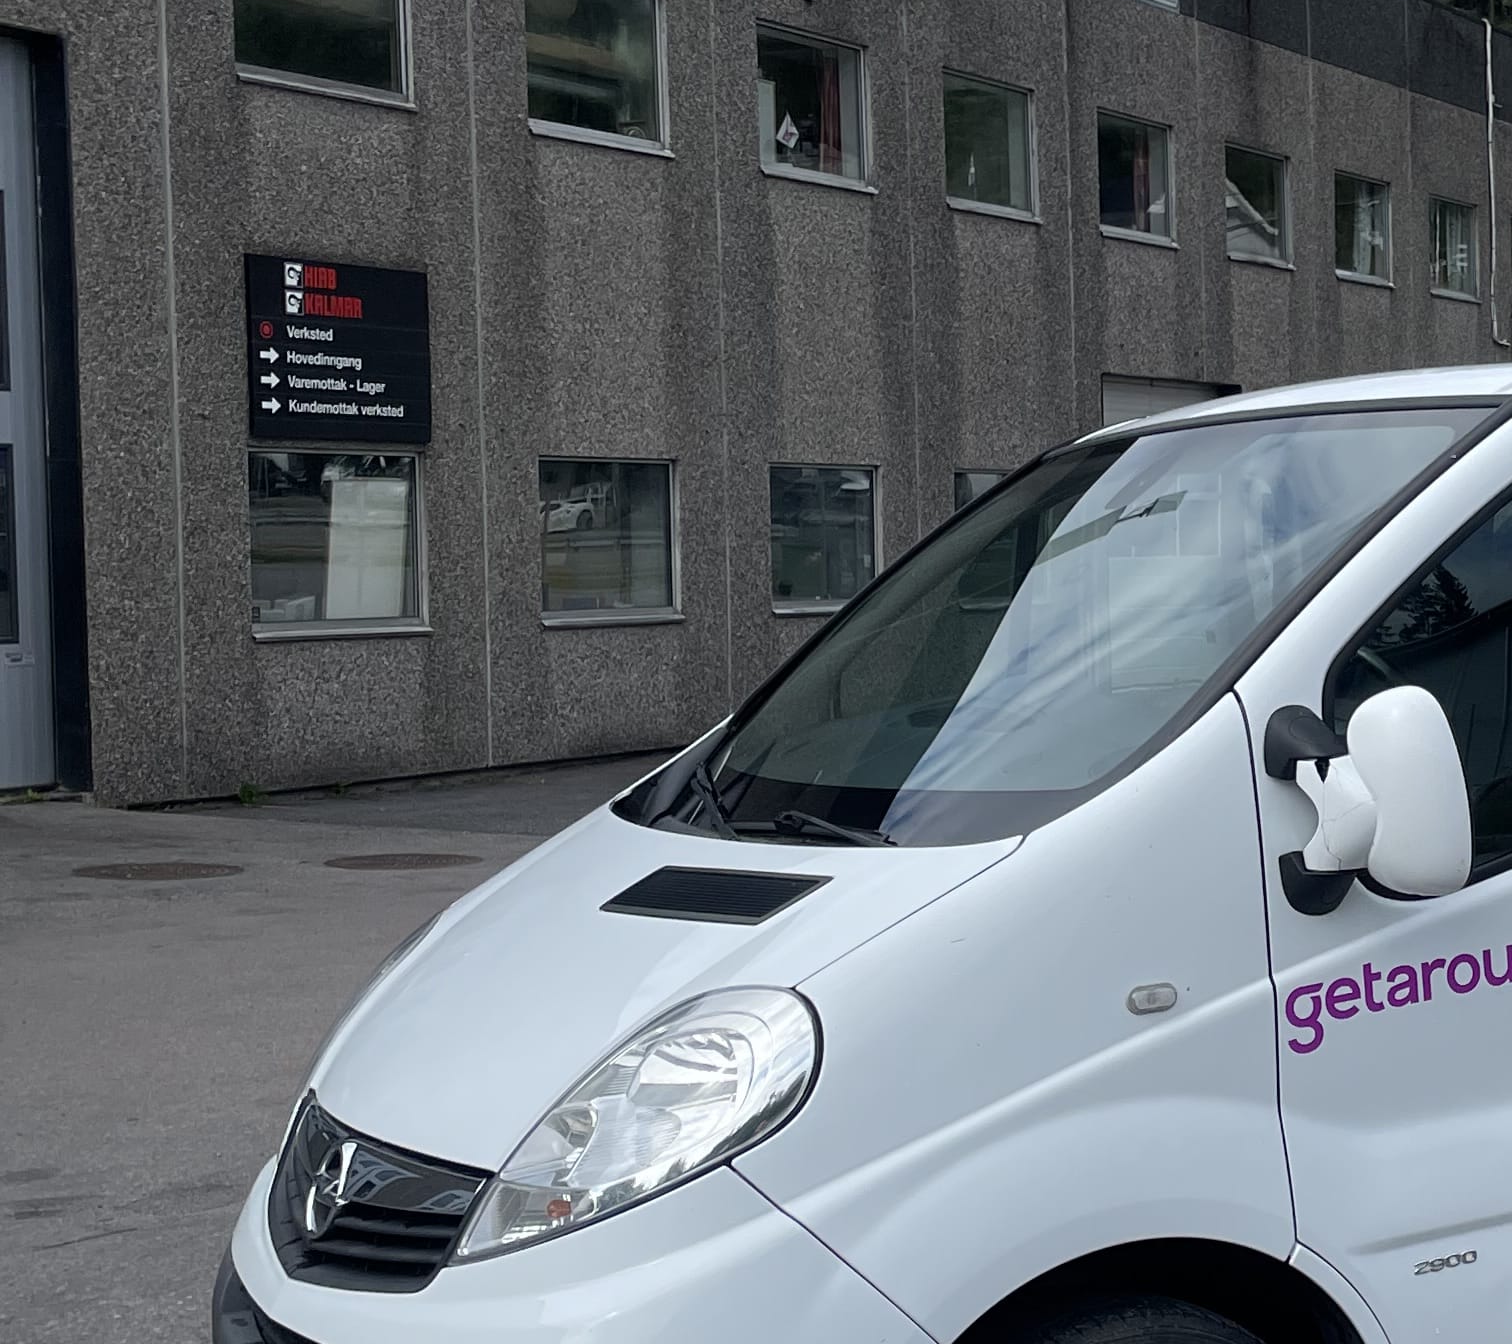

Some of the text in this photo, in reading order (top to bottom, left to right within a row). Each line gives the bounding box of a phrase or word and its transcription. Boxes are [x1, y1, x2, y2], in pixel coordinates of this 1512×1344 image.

[304, 265, 337, 290] HIAB
[304, 293, 363, 319] KALMAR
[286, 324, 334, 341] Verksted
[286, 350, 362, 371] Hovedinngang
[287, 374, 347, 392] Varemottak
[356, 379, 386, 395] Lager
[288, 399, 404, 417] Kundemottak verksted
[1414, 1249, 1478, 1276] 2900
